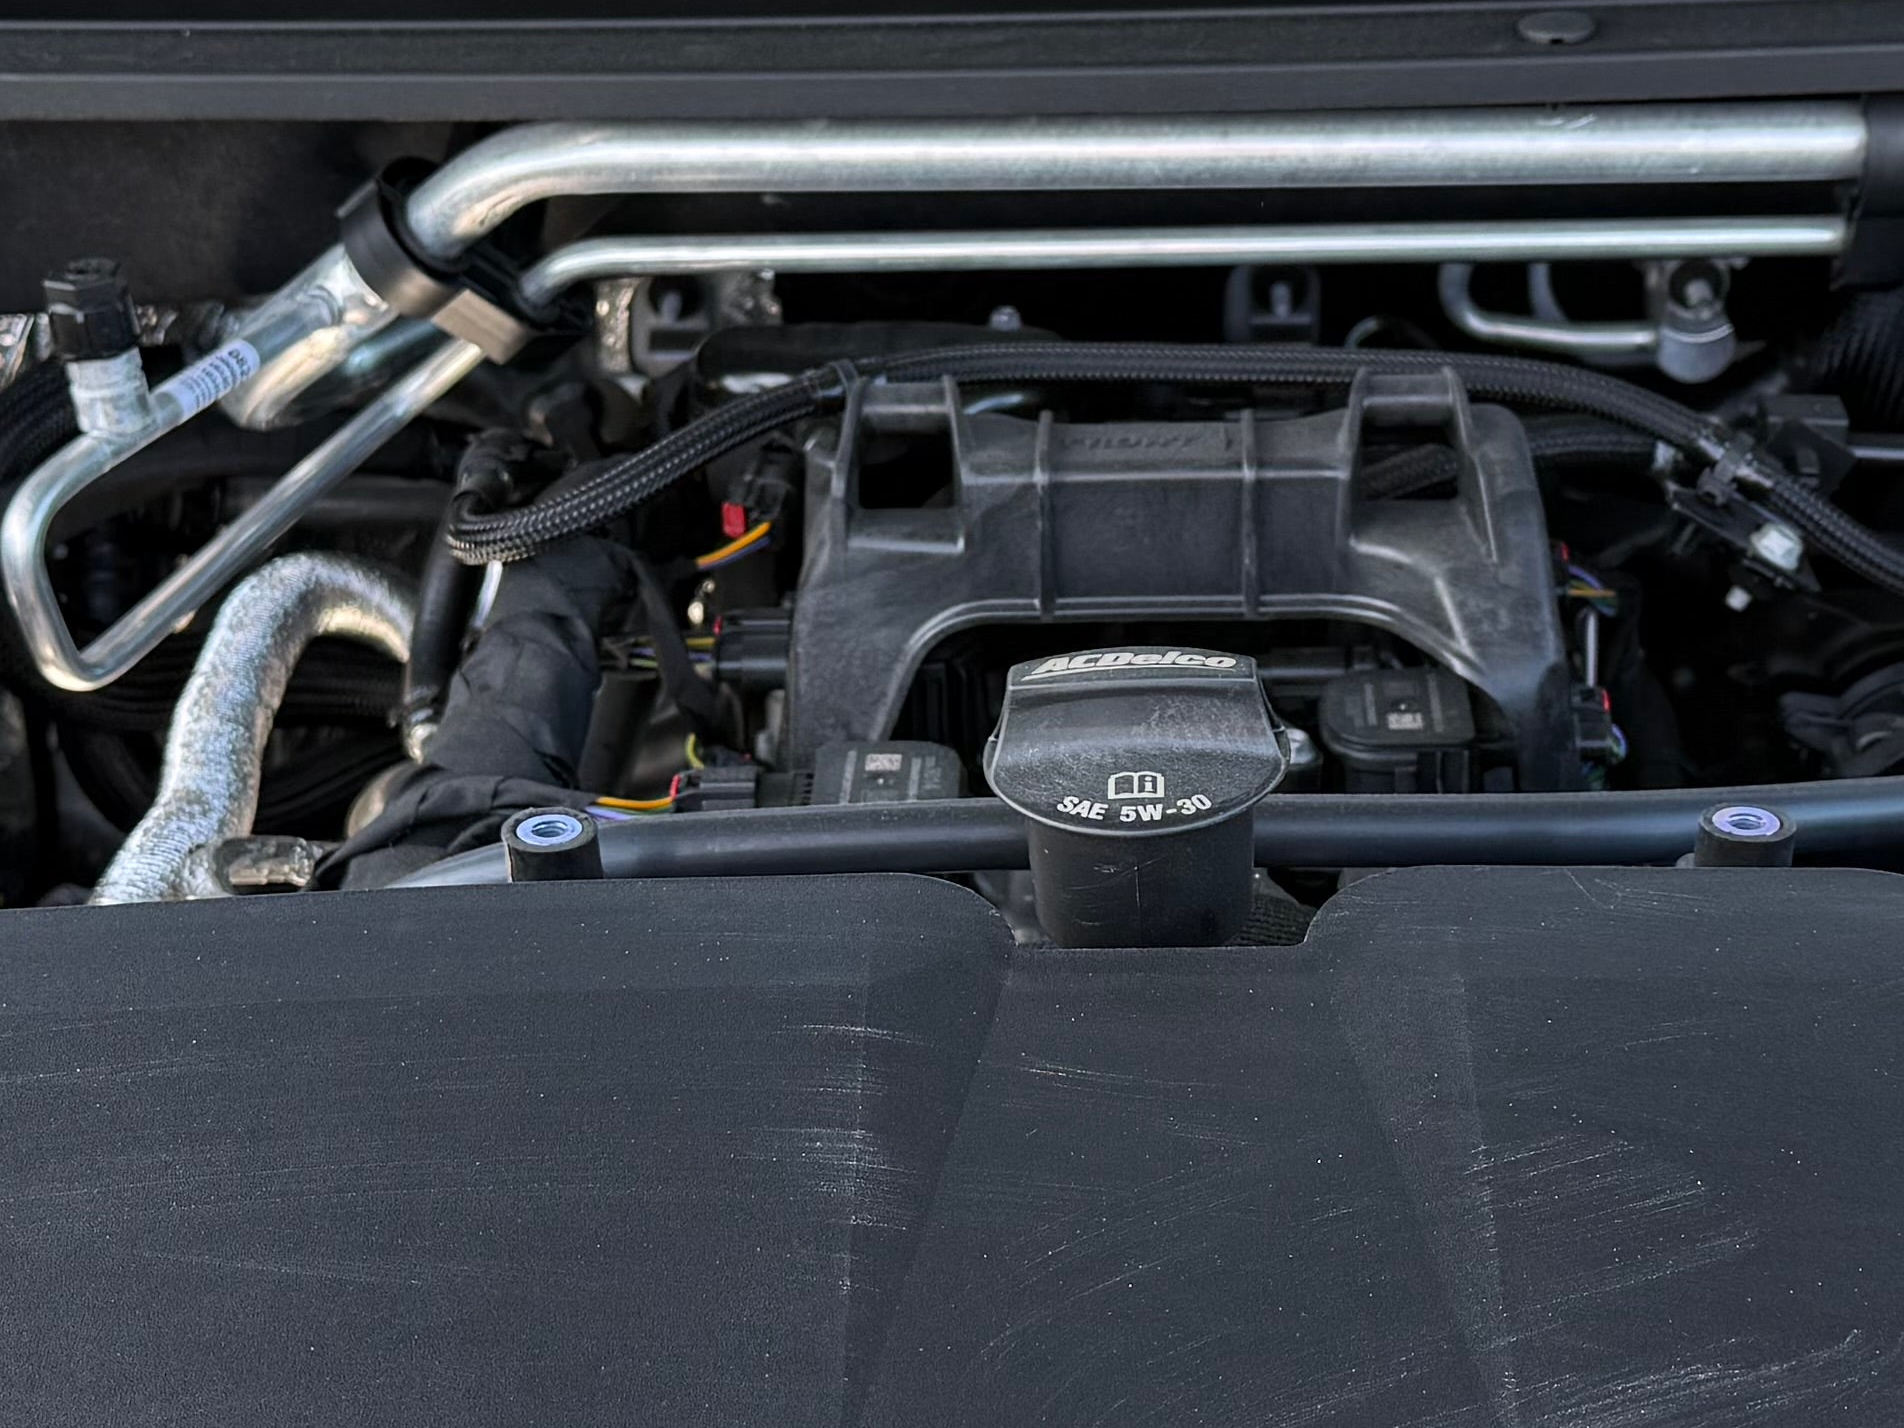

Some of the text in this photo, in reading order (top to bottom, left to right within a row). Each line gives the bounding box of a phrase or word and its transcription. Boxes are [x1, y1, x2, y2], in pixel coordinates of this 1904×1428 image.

[1031, 651, 1237, 674] ACDelco
[1057, 794, 1212, 822] SAE 5W-30
